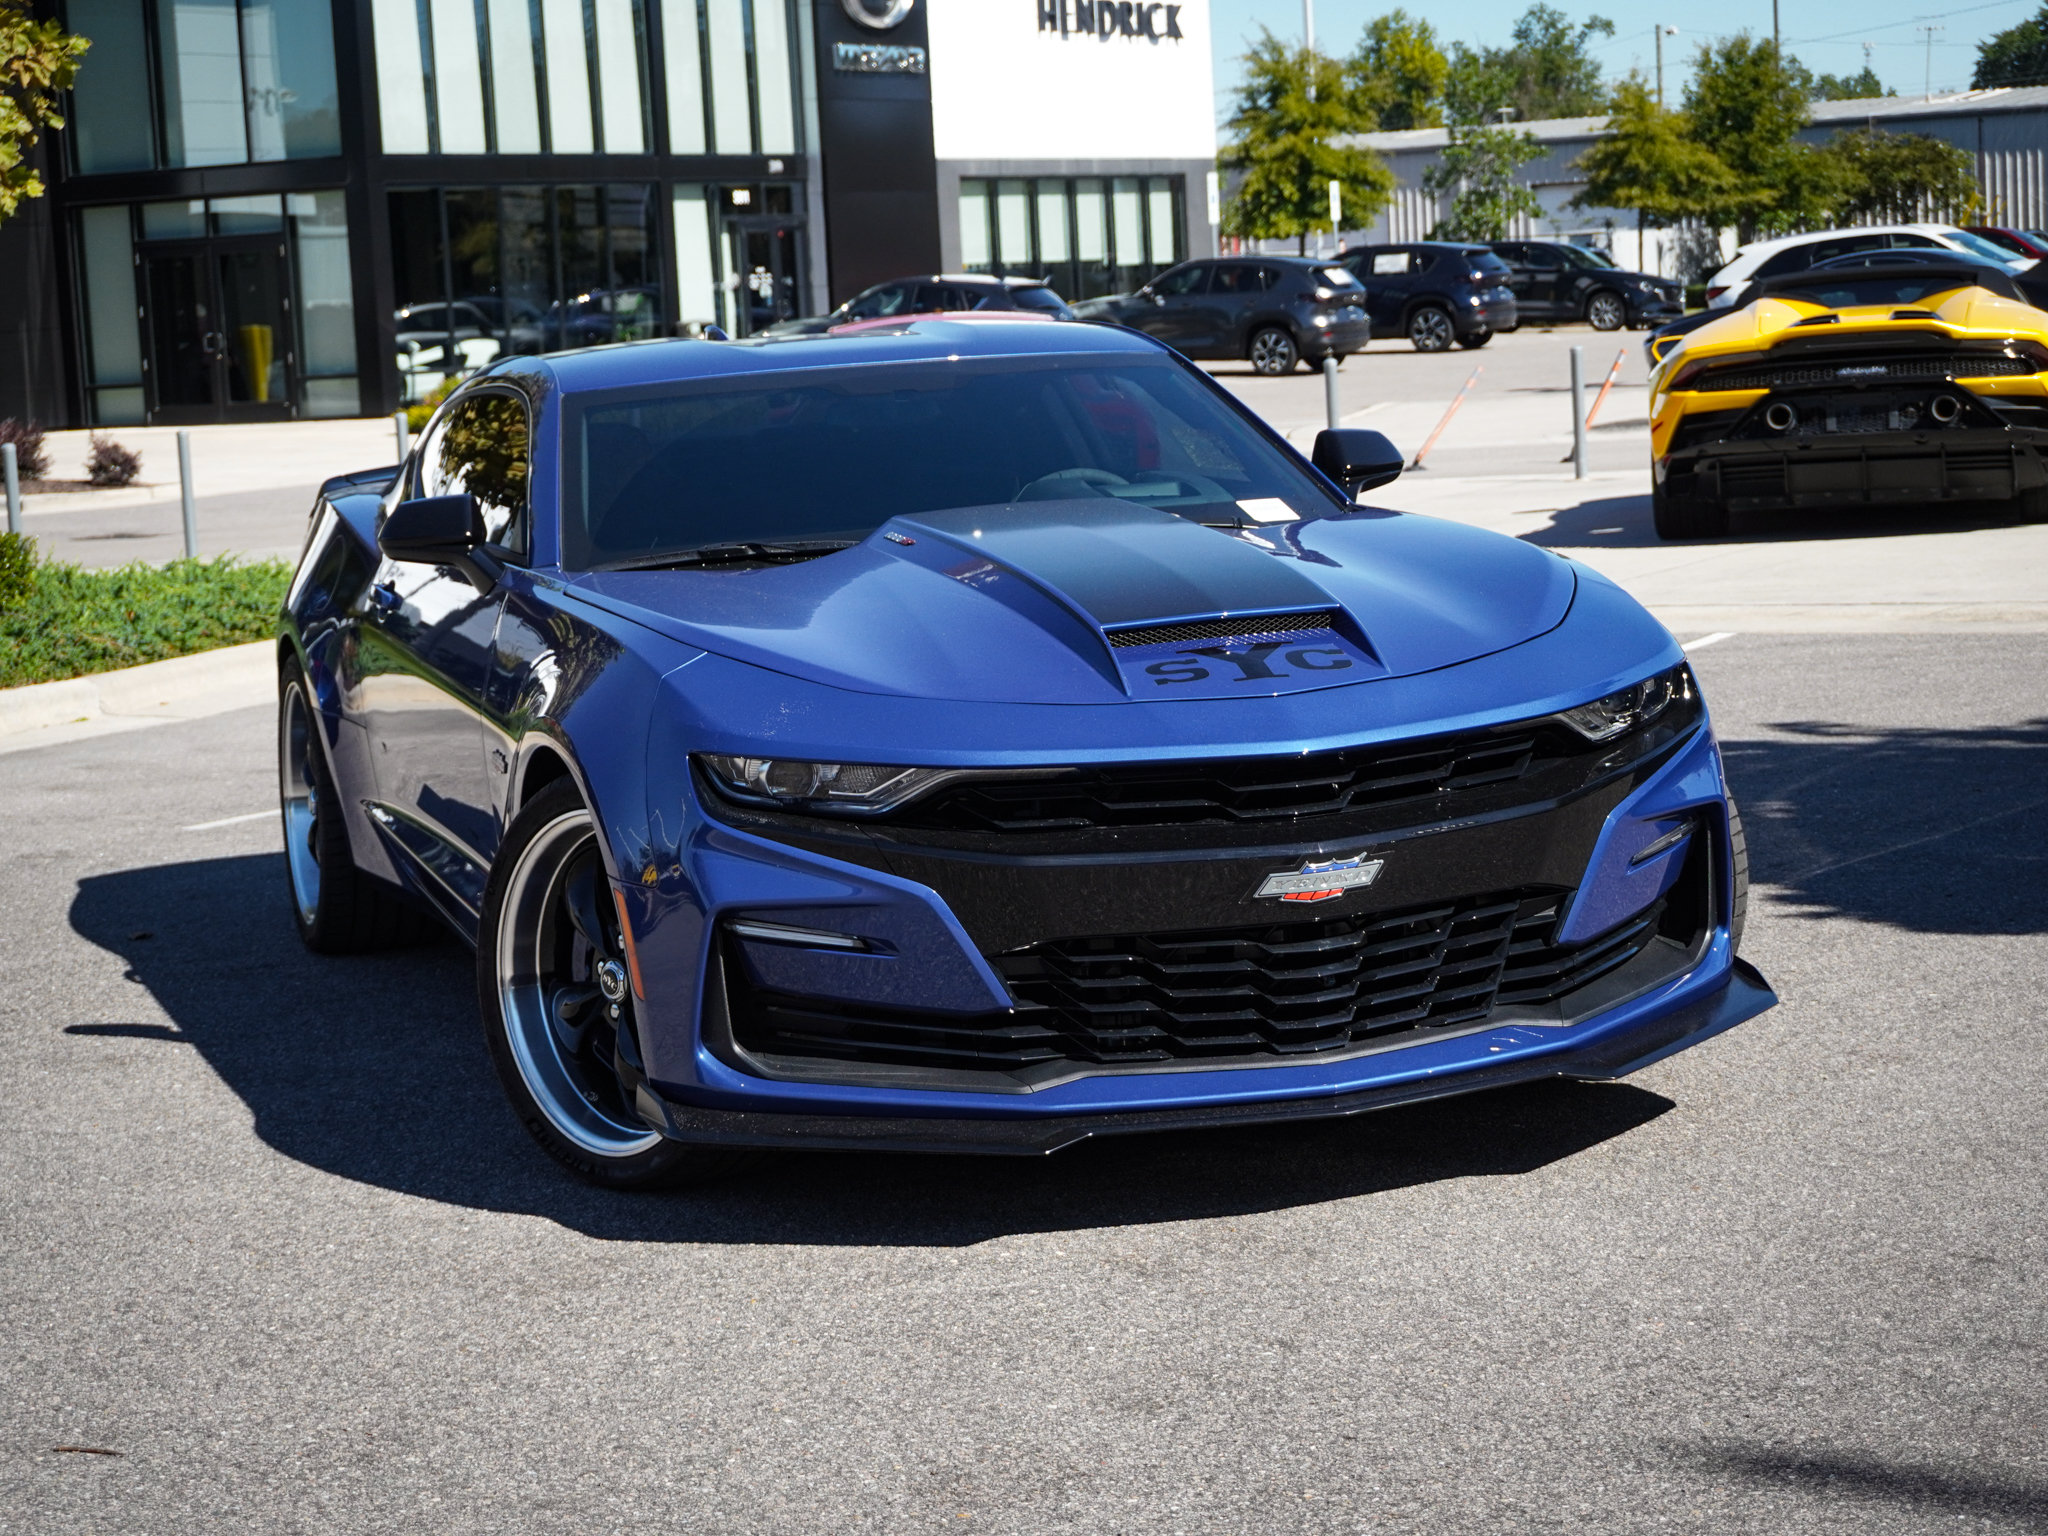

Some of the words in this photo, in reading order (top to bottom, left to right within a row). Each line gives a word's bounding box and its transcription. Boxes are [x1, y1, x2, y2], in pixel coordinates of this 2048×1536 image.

[1037, 0, 1183, 42] HENDRICK
[1145, 640, 1353, 686] SYC
[602, 973, 617, 991] SYC
